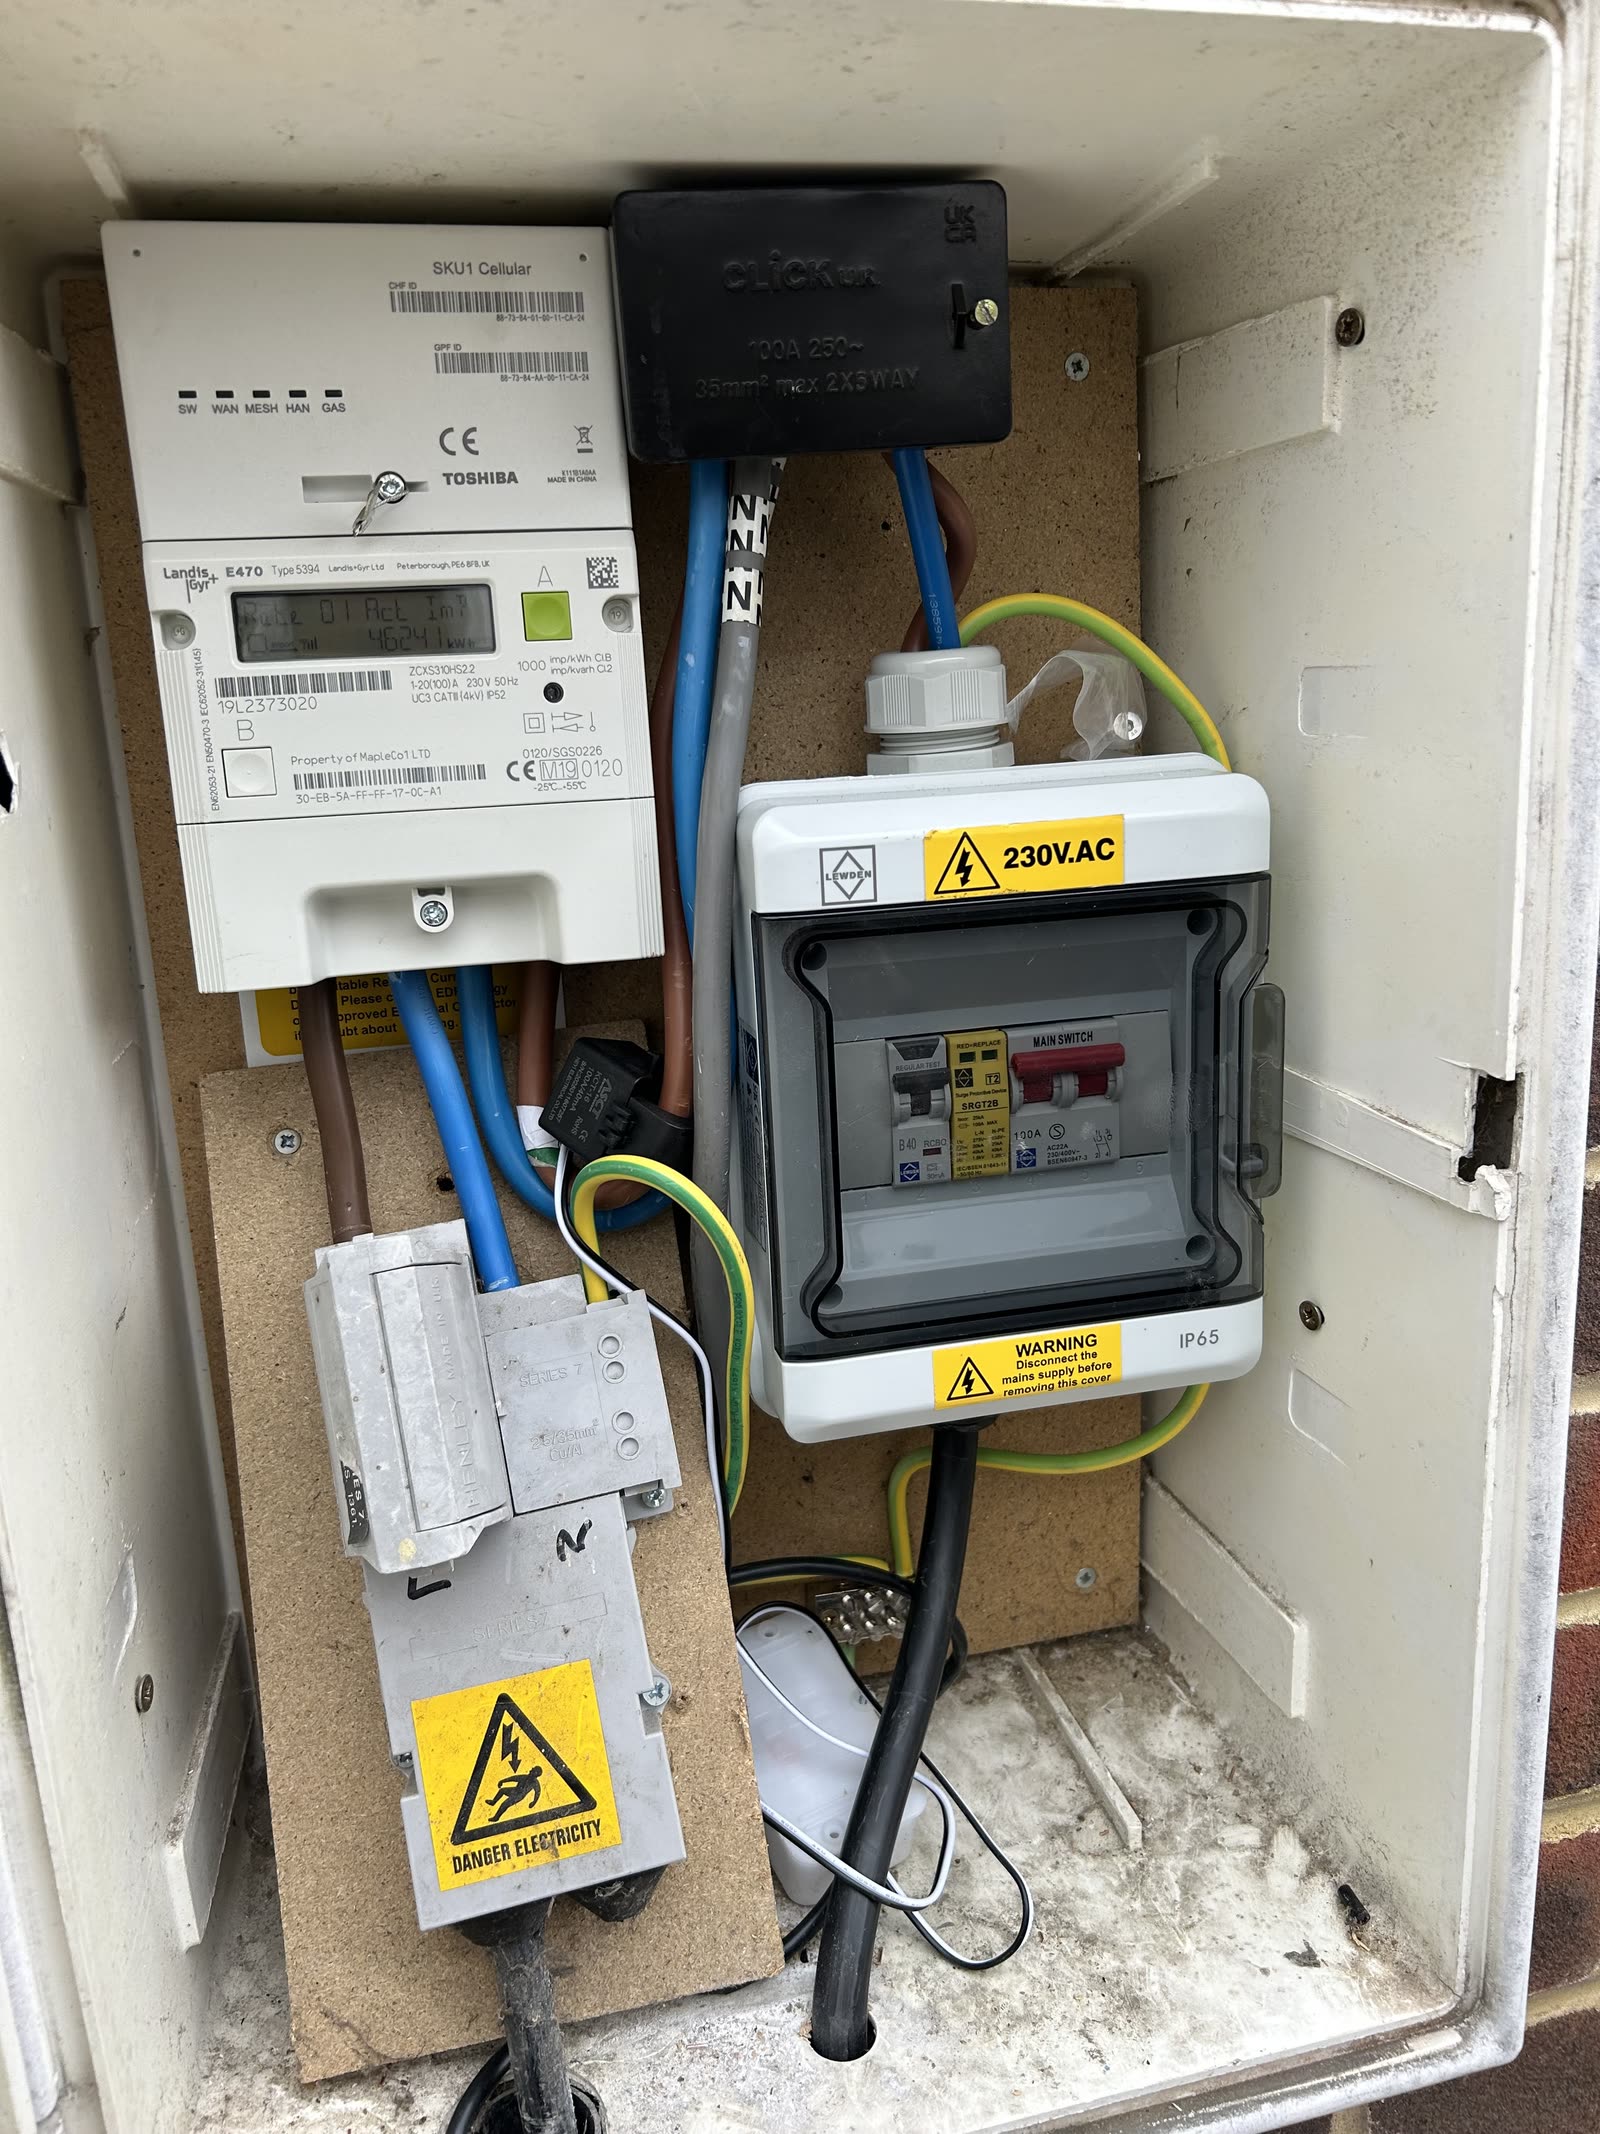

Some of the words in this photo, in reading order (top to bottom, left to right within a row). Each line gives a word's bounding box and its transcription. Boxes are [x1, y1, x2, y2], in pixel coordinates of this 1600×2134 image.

[944, 205, 976, 224] UK
[433, 262, 473, 275] SKU1
[478, 262, 532, 275] Cellular
[748, 339, 801, 359] 100A
[776, 375, 819, 395] max
[178, 404, 197, 414] SW
[212, 404, 239, 414] WAN
[245, 403, 278, 413] MESH
[286, 403, 310, 413] HAN
[321, 402, 346, 412] GAS
[442, 471, 519, 485] TOSHIBA
[732, 494, 757, 520] N
[730, 529, 754, 551] N
[226, 566, 263, 577] E470
[272, 565, 295, 577] Type
[296, 564, 320, 574] 5394
[328, 564, 371, 572] Landis+Gyr
[371, 563, 385, 571] Ltd
[537, 565, 553, 587] A
[726, 580, 751, 611] N
[610, 610, 622, 619] 19
[448, 637, 476, 649] kWh
[518, 660, 547, 671] 1000
[550, 654, 592, 664] imp/kWh
[551, 665, 595, 675] imp/kvarh
[217, 696, 318, 714] 19L2373020
[411, 692, 432, 703] UC3
[460, 690, 484, 702] (4kV)
[487, 690, 506, 700] IP52
[236, 719, 255, 741] B
[201, 719, 215, 763] EN50470-3
[290, 754, 343, 767] Property
[345, 753, 358, 763] of
[411, 749, 431, 759] LTD
[522, 746, 603, 759] 0120/SGS0226
[541, 760, 577, 779] M19
[581, 758, 623, 778] 0120
[207, 766, 220, 811] EN62053-21
[1004, 837, 1115, 869] 230V.AC
[825, 869, 872, 882] LEWDEN
[341, 994, 383, 1005] Please
[337, 1007, 388, 1023] pproved
[361, 1024, 398, 1035] about
[1033, 1035, 1056, 1048] MAIN
[1058, 1031, 1094, 1045] SWITCH
[895, 1063, 925, 1072] REGULAR
[987, 1074, 1000, 1084] T2
[961, 1100, 999, 1111] SRGT2B
[570, 1115, 584, 1136] RoHS
[1014, 1129, 1042, 1140] 100A
[923, 1139, 947, 1147] RCBO
[1015, 1333, 1098, 1358] WARNING
[1178, 1329, 1220, 1350] IP65
[441, 1335, 456, 1380] MADE
[1016, 1353, 1078, 1370] Disconnect
[1080, 1350, 1098, 1361] the
[519, 1367, 568, 1388] SERIES
[572, 1362, 584, 1376] 7
[1002, 1371, 1035, 1385] mains
[1038, 1367, 1075, 1382] supply
[1077, 1360, 1113, 1373] before
[1003, 1381, 1056, 1398] removing
[1057, 1377, 1079, 1389] this
[1080, 1373, 1112, 1386] cover
[449, 1393, 480, 1508] HENLEY
[452, 1842, 512, 1874] DANGER
[514, 1818, 601, 1858] ELECTRICITY
